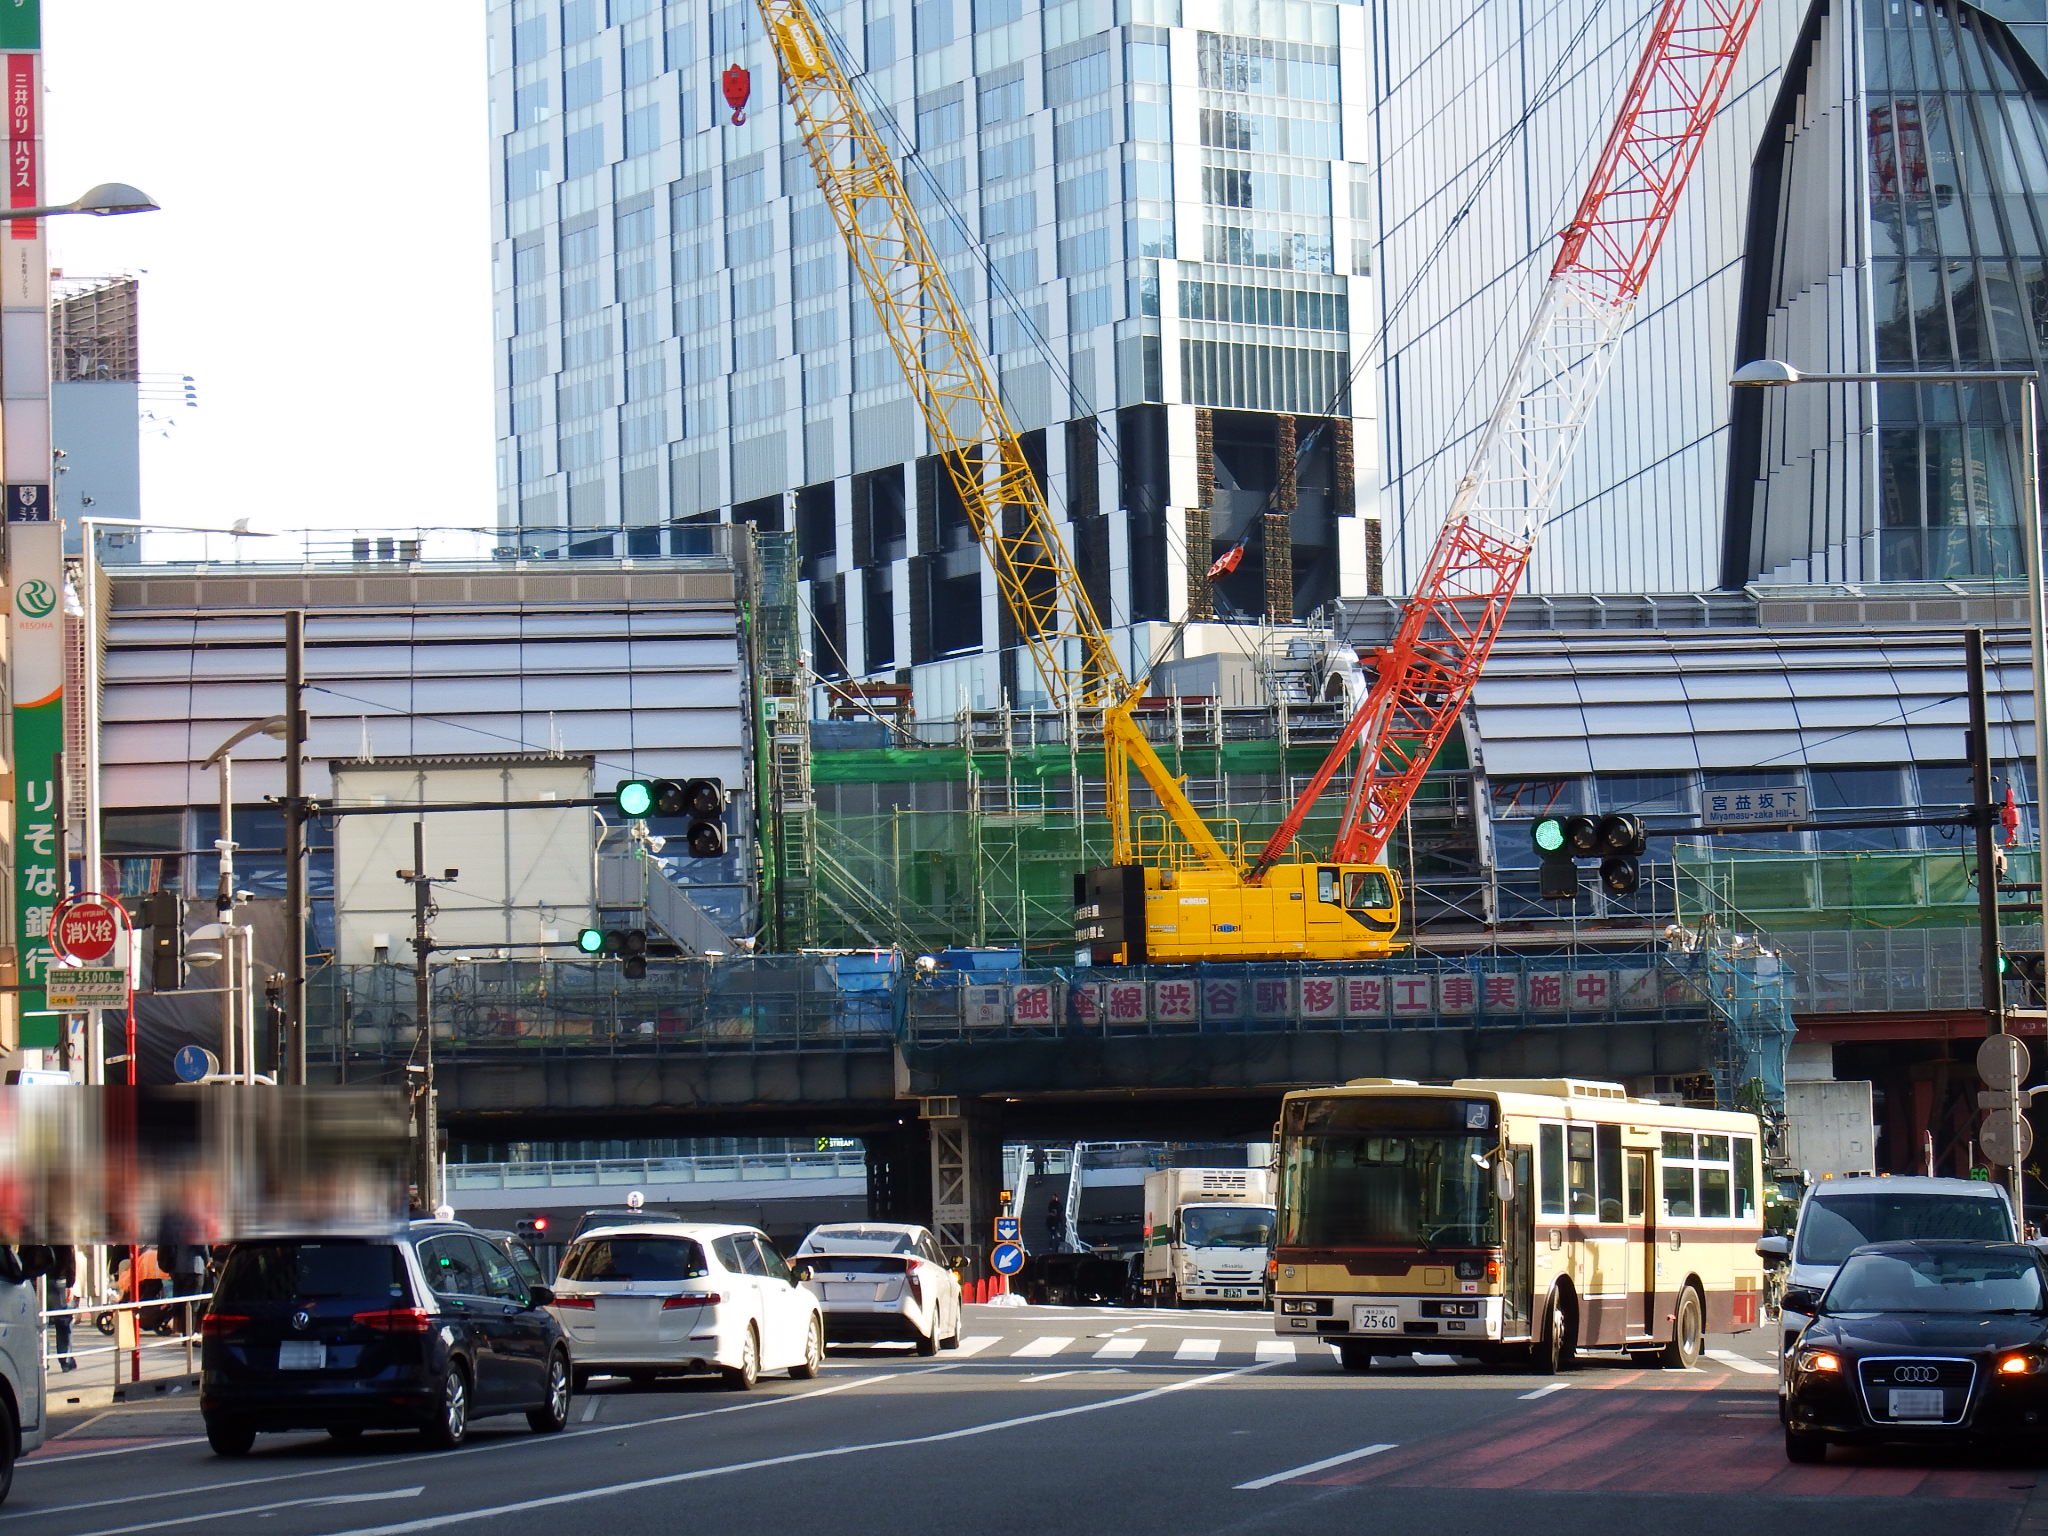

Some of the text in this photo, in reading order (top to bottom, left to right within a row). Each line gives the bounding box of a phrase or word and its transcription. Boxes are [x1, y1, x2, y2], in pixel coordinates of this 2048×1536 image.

[19, 622, 54, 631] RESONA
[1711, 791, 1798, 811] 宮益坂下
[1709, 810, 1773, 822] Miyamasu-zaka
[24, 780, 57, 980] りそな銀行
[69, 909, 107, 919] FIRE HYDRANT
[66, 919, 113, 945] 消火栓
